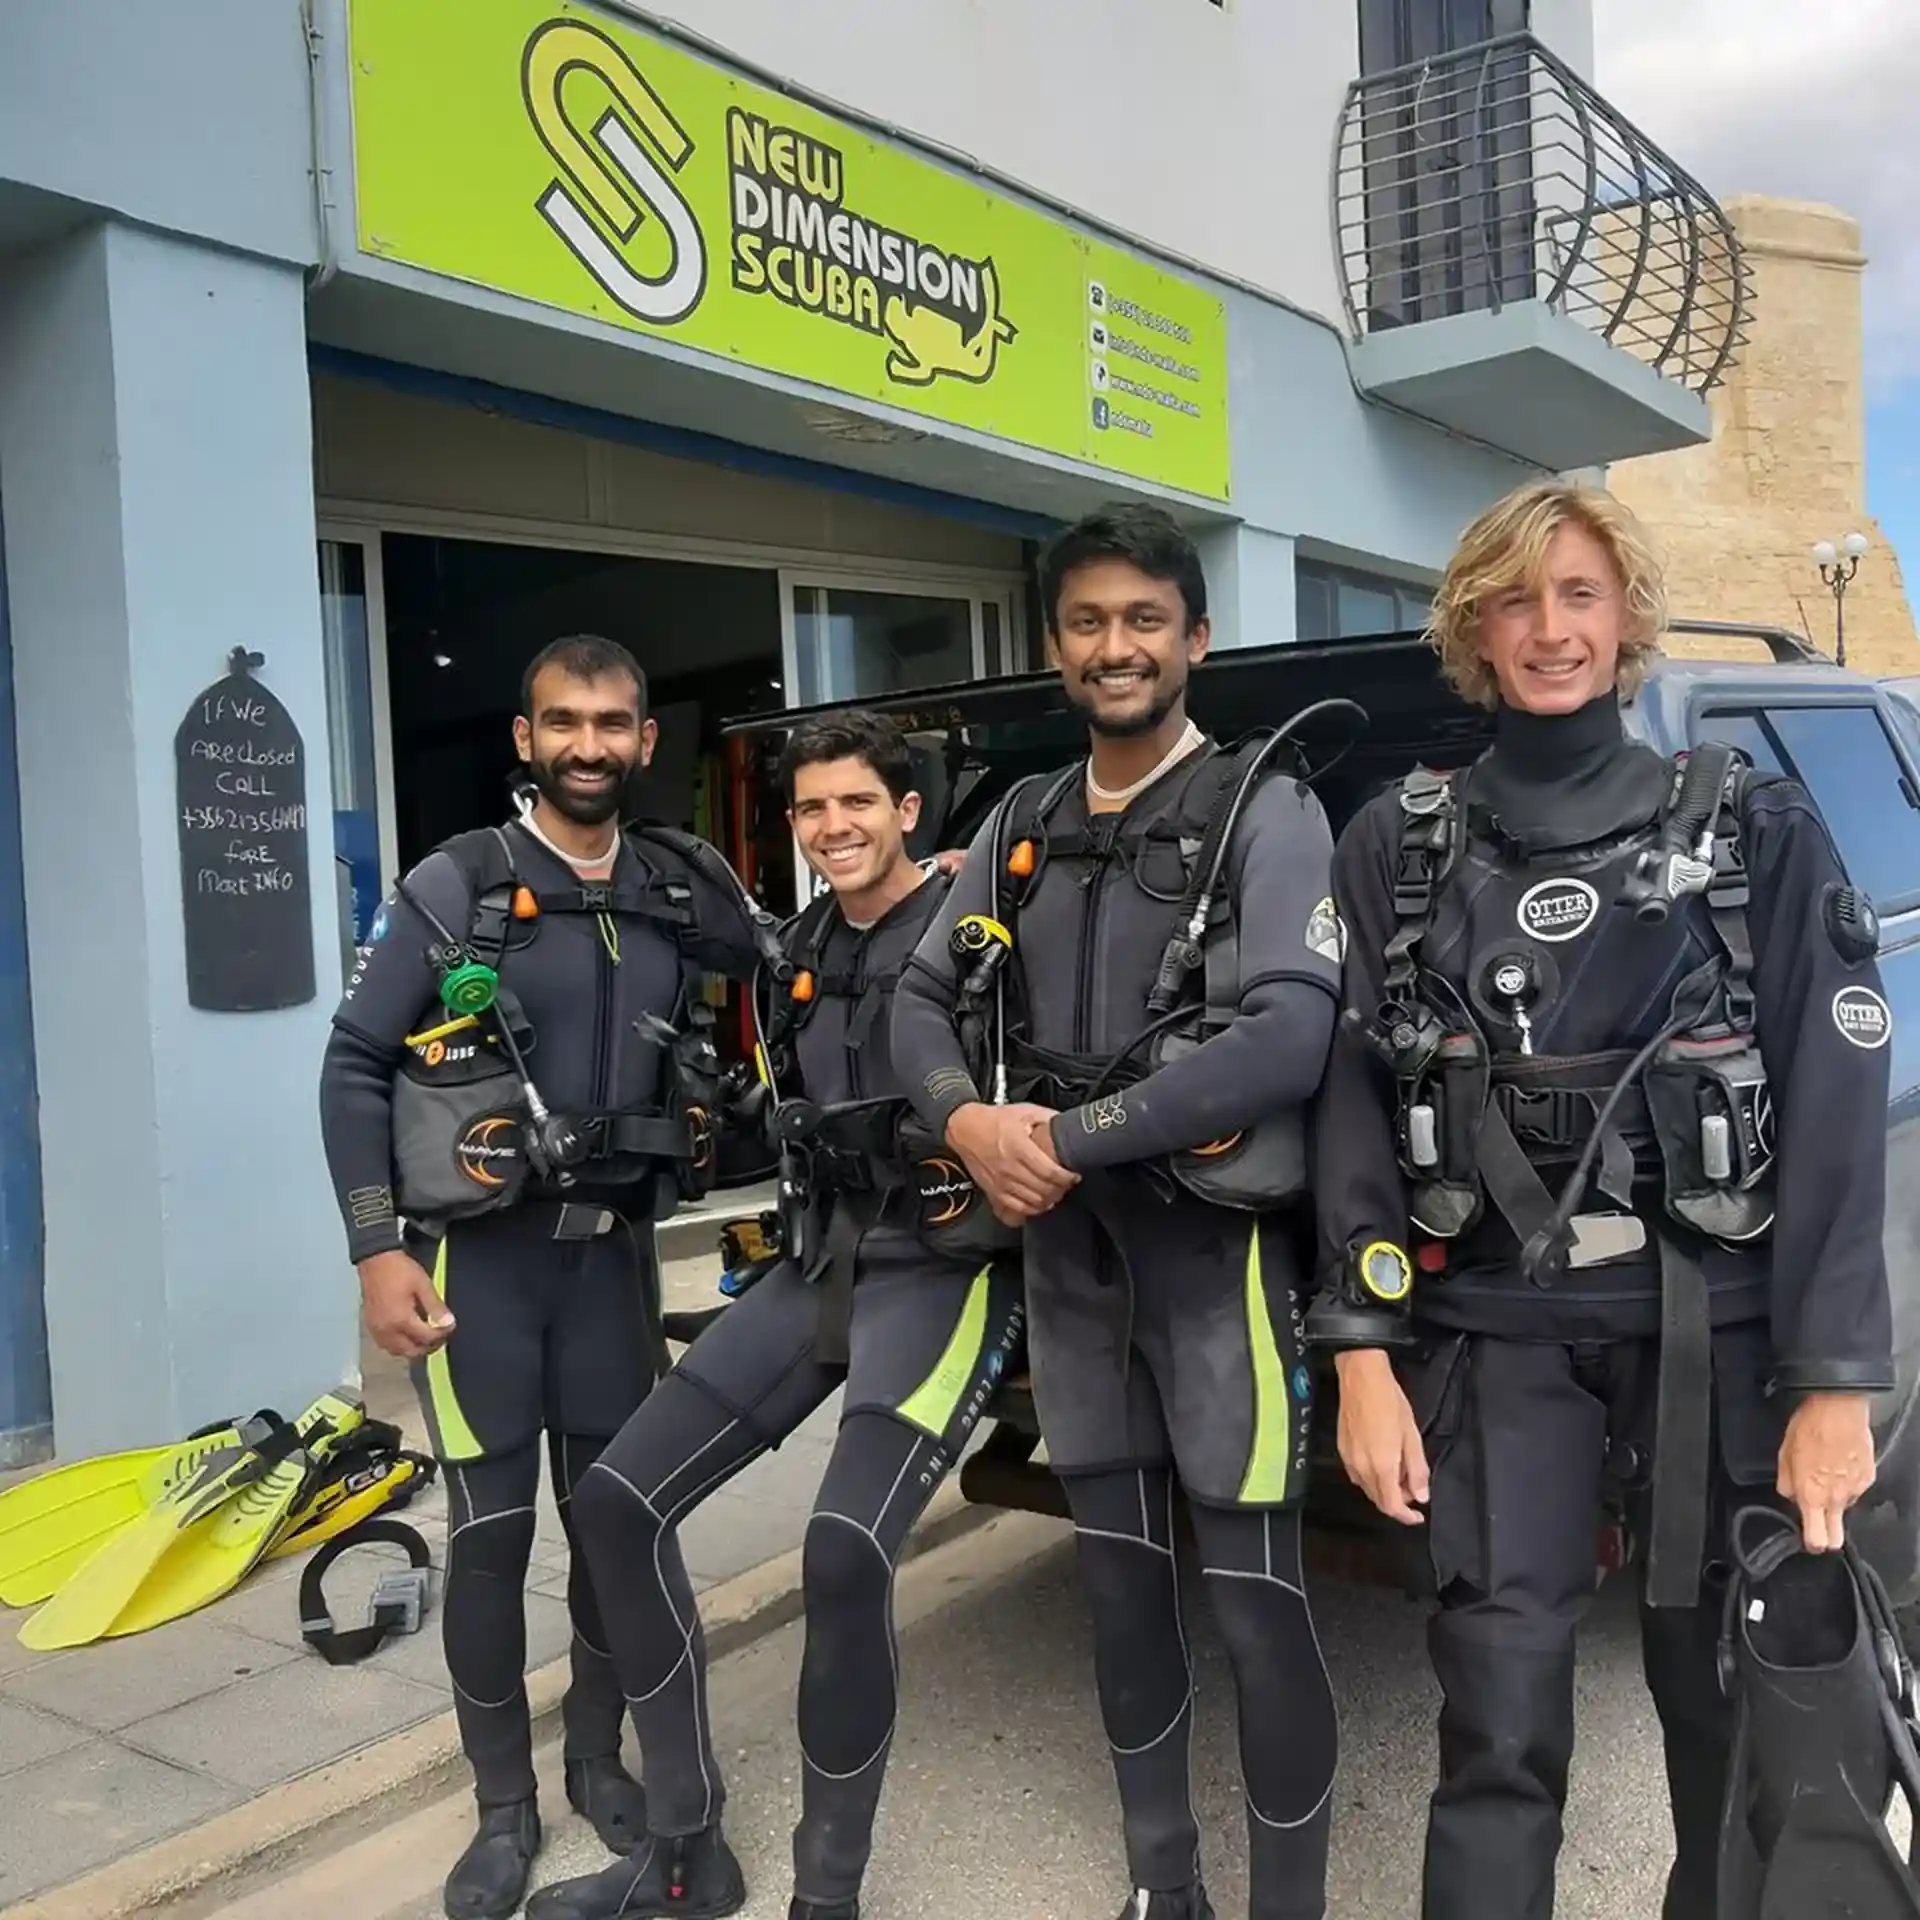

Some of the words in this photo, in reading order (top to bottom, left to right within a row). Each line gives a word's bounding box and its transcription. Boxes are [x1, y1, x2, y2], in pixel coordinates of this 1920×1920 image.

[729, 109, 842, 203] NEW
[734, 174, 978, 314] DIMENSION
[736, 234, 883, 330] SCUBA
[231, 698, 267, 726] We
[1527, 892, 1590, 919] OTTER
[1839, 1001, 1885, 1025] OTTER
